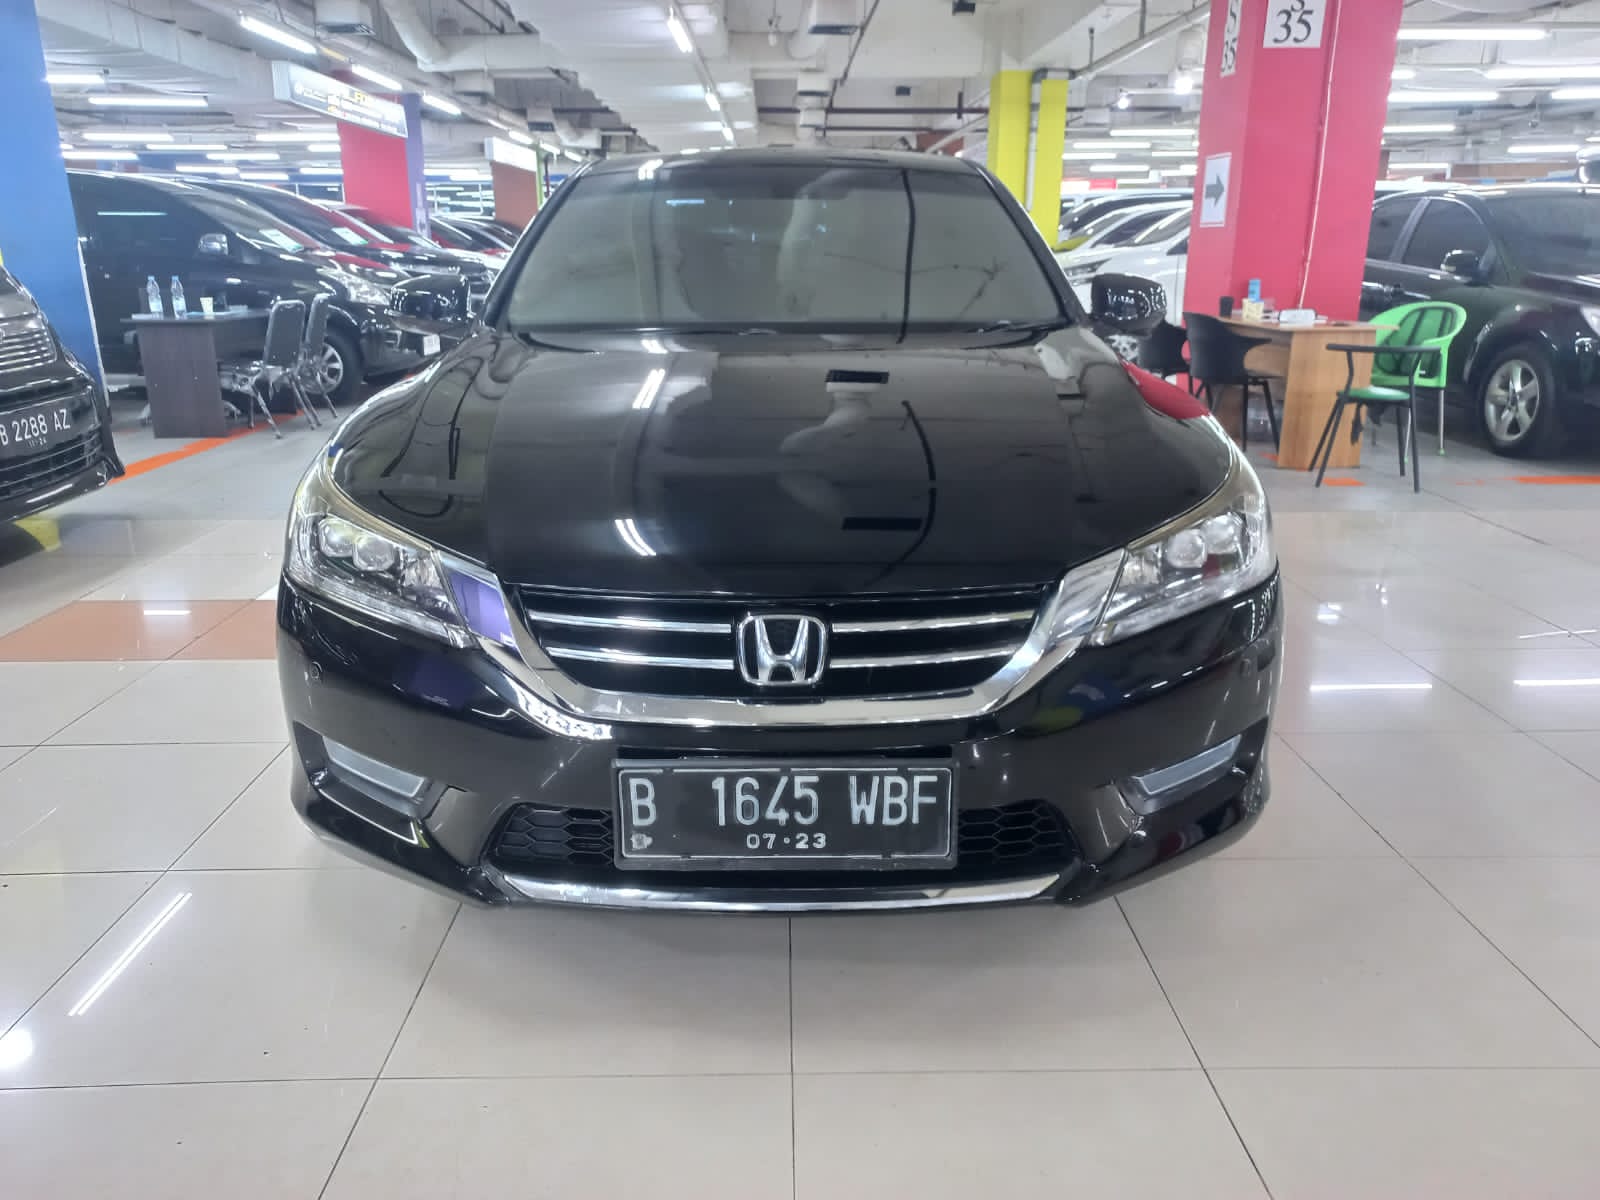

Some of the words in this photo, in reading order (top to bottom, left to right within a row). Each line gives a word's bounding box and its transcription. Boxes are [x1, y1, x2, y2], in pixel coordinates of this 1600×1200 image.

[1273, 9, 1314, 44] 35
[0, 424, 9, 446] B
[12, 413, 48, 442] 2288
[53, 408, 71, 431] AZ
[629, 777, 657, 826] B
[711, 775, 820, 826] 1645
[849, 775, 939, 826] WBF
